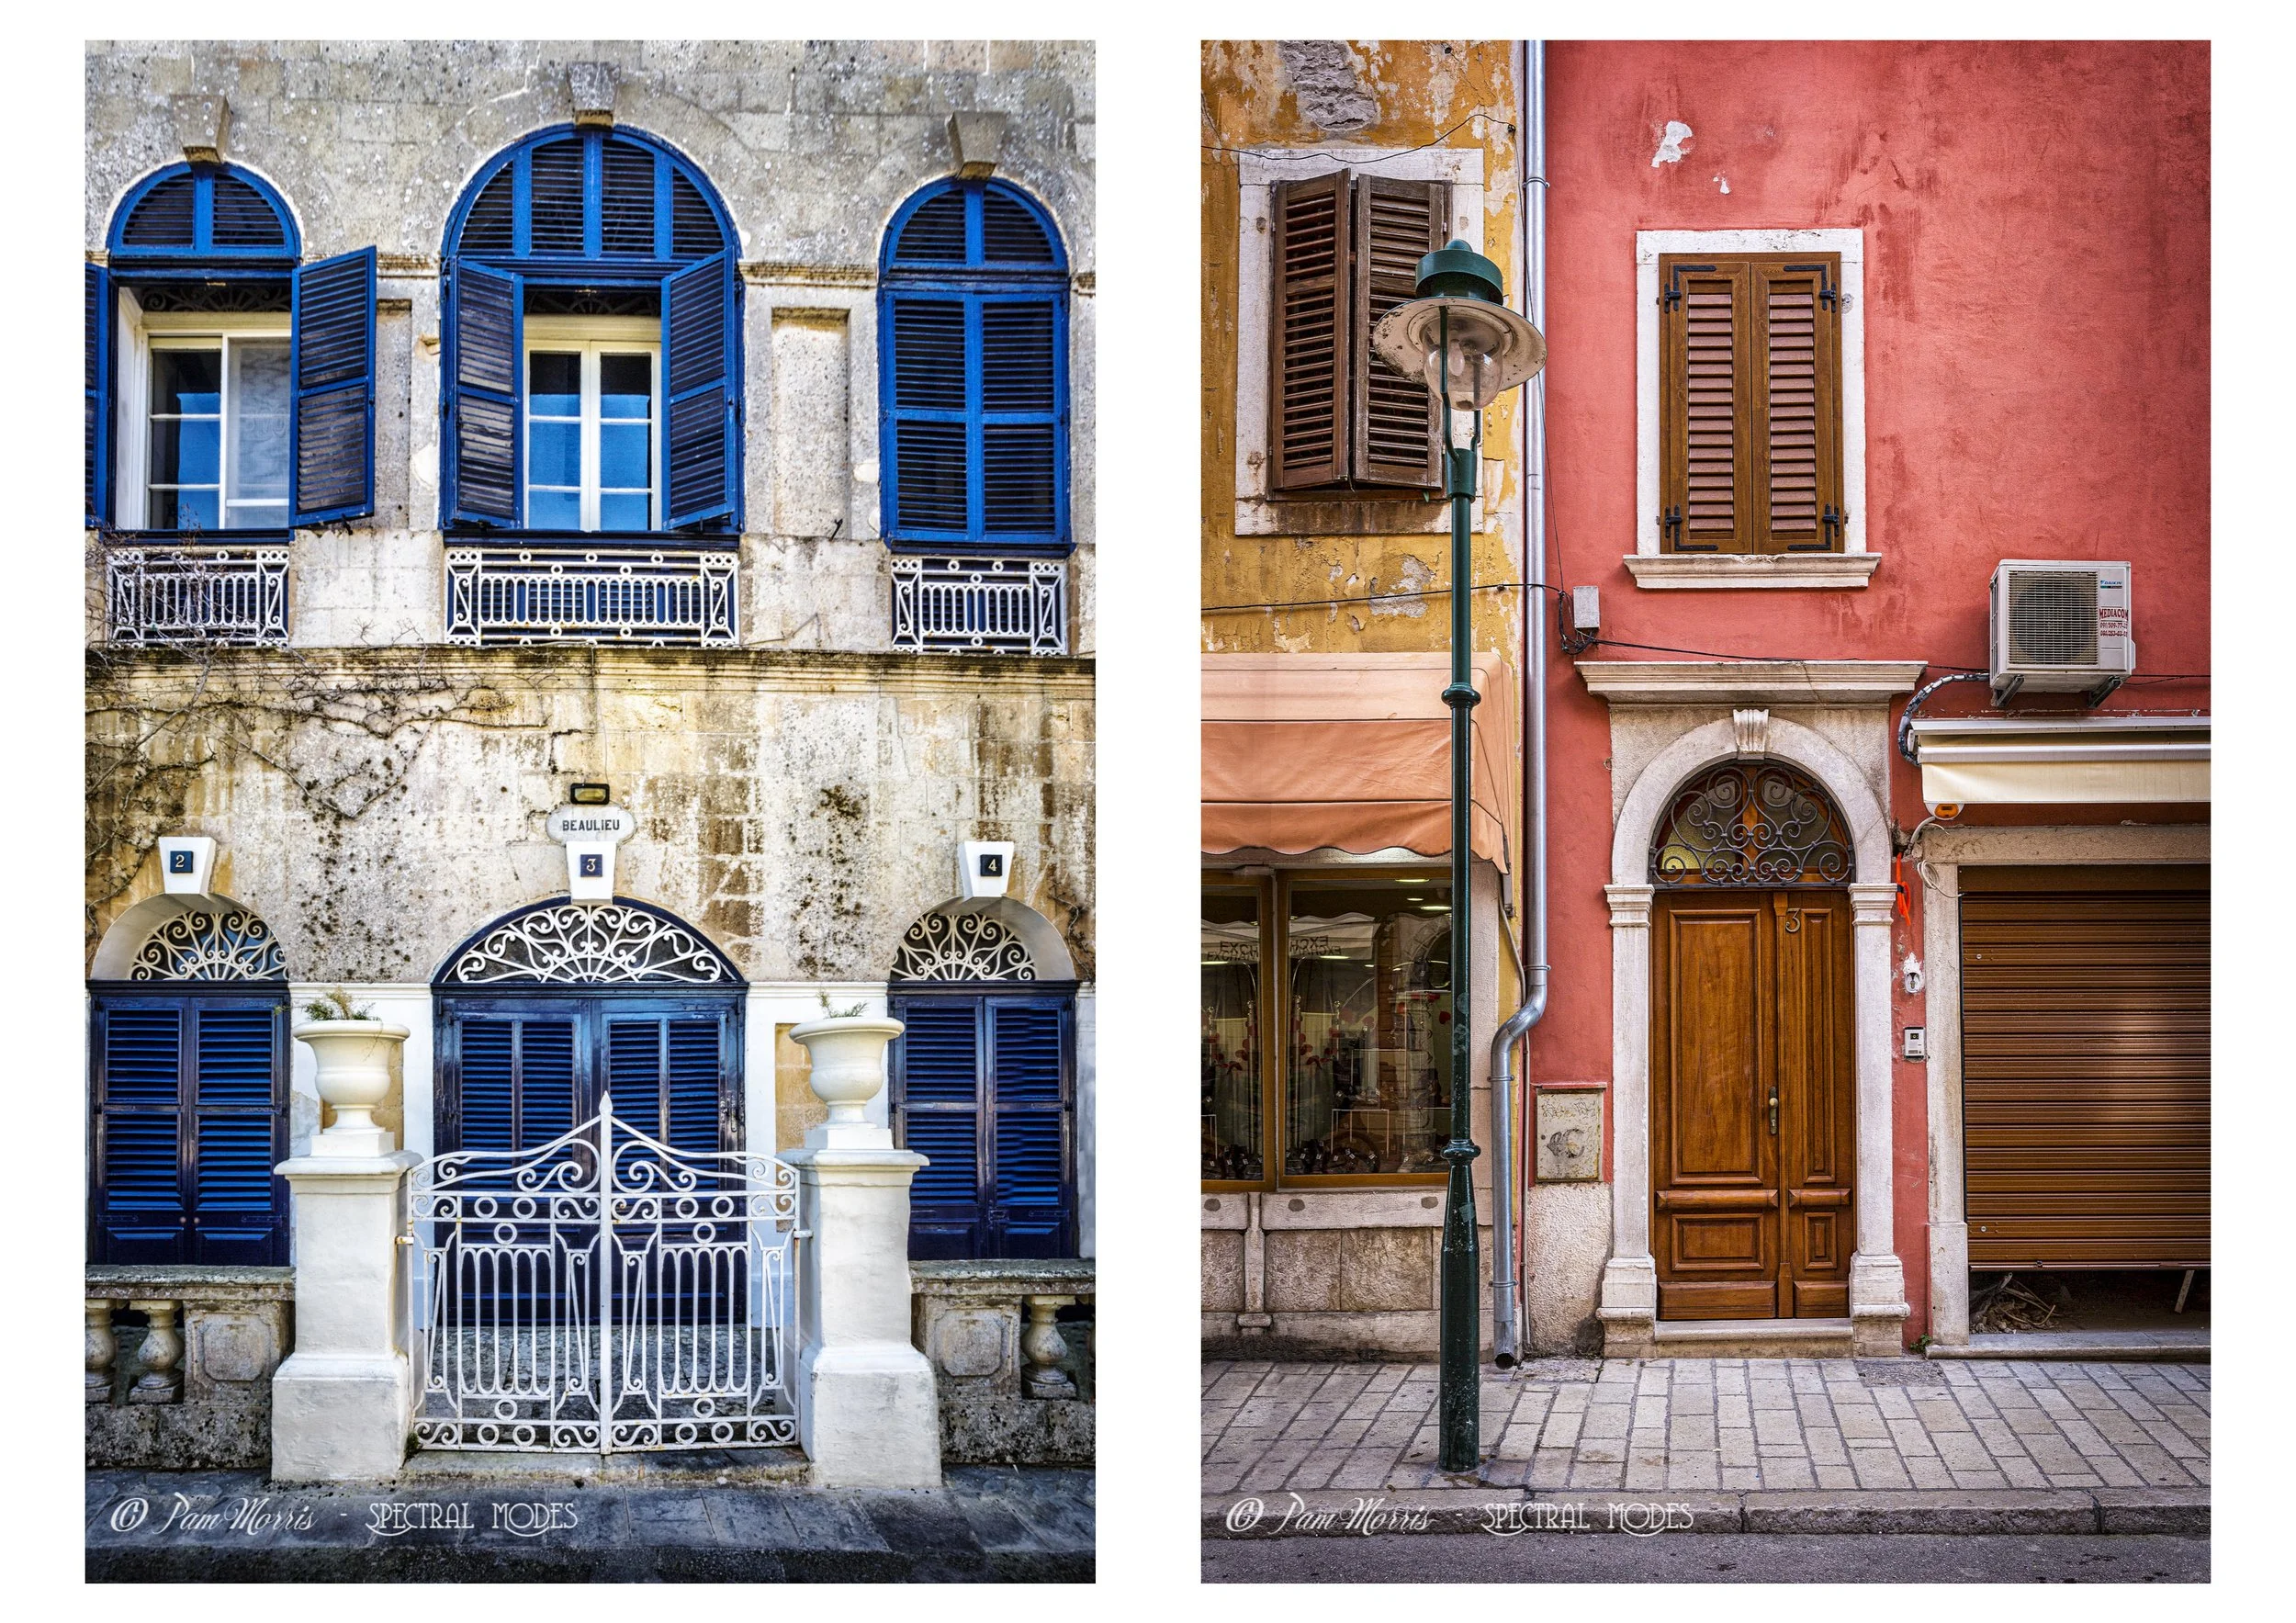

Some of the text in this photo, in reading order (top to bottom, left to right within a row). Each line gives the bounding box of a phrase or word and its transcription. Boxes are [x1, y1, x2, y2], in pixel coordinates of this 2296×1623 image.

[2099, 609, 2129, 621] MEDIACOM
[562, 819, 620, 831] BEAULIEU
[175, 854, 185, 868] 2
[586, 858, 596, 873] 3
[988, 858, 997, 872] 4
[1785, 907, 1801, 932] 3
